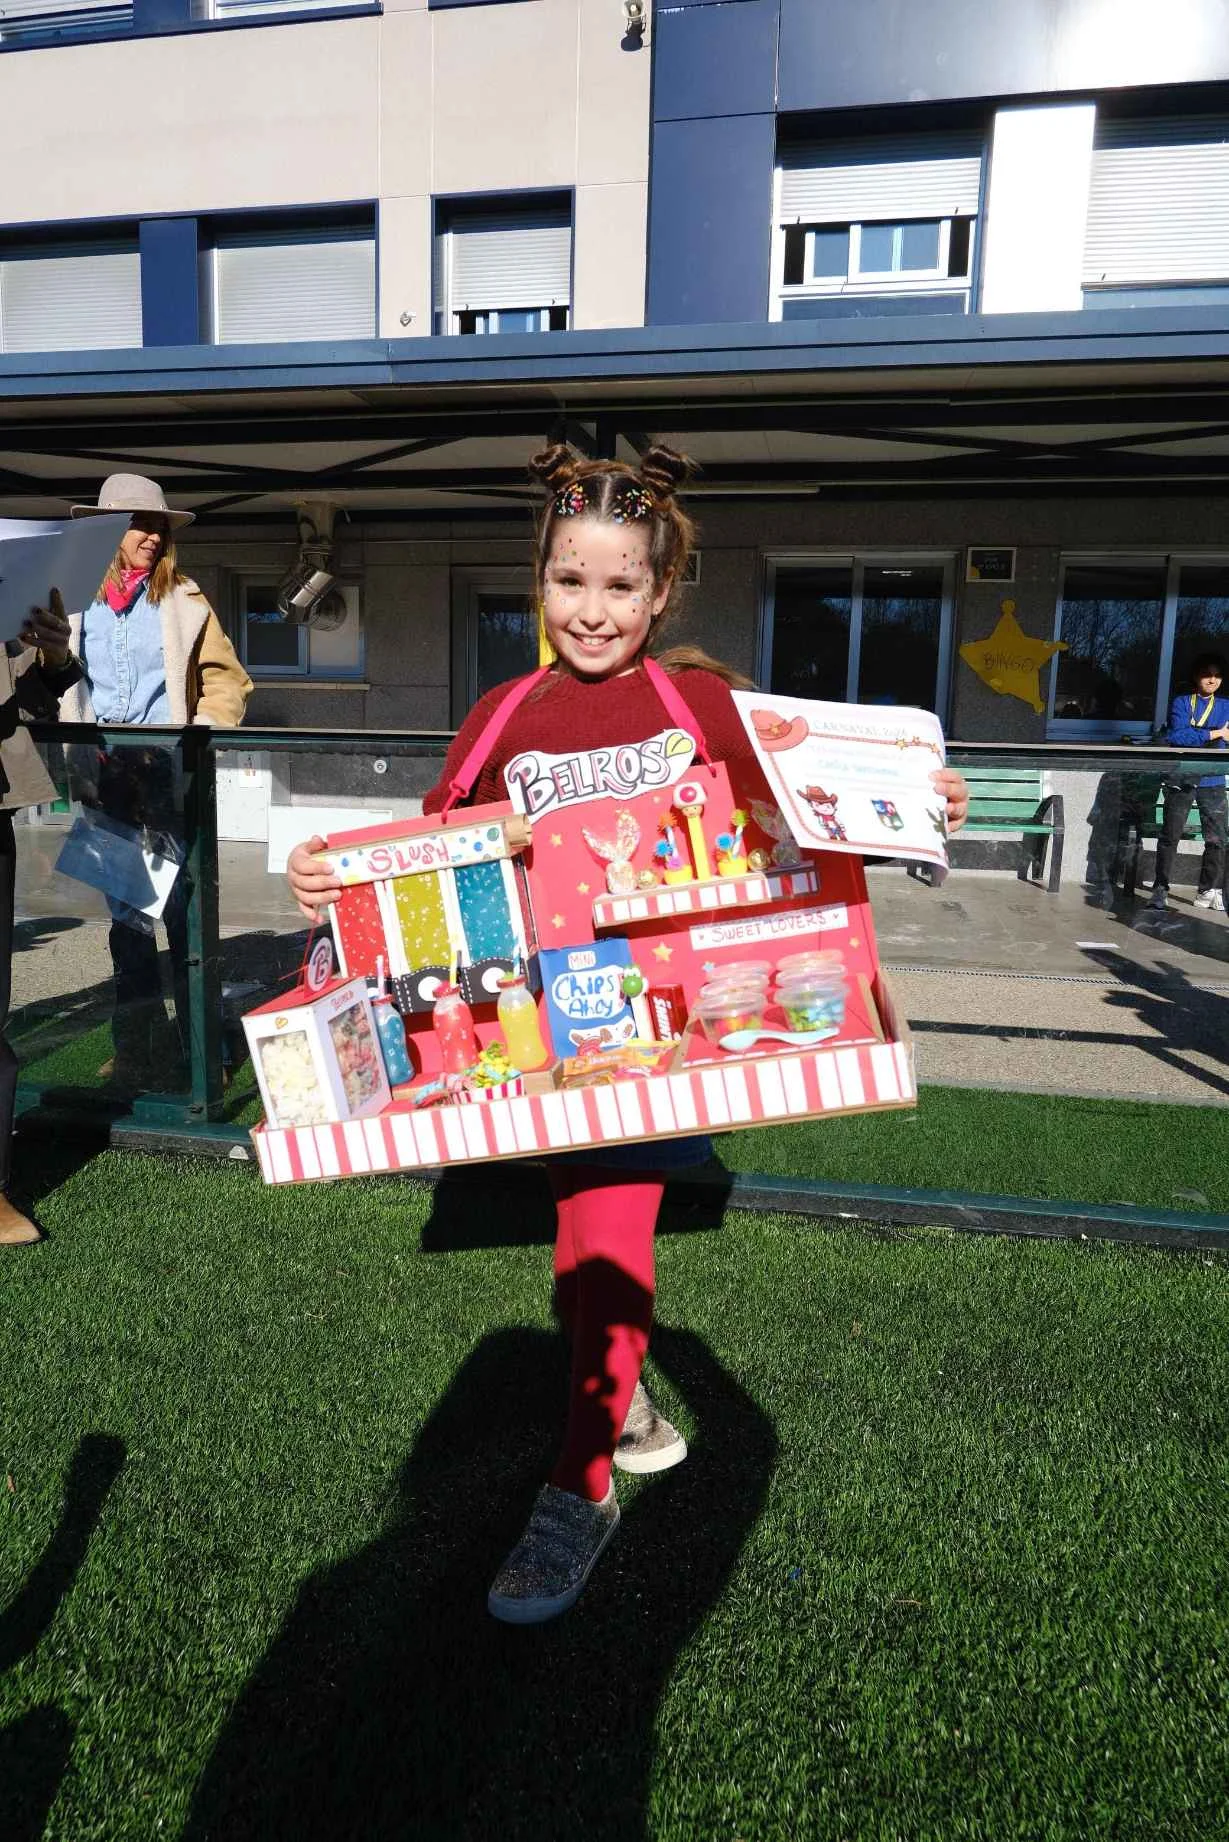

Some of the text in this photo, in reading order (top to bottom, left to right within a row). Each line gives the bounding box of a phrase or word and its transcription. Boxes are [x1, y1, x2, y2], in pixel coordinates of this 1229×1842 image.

[508, 741, 671, 816] BELROS
[367, 838, 450, 874] SLUSH
[711, 911, 827, 943] SWEET LOVERS
